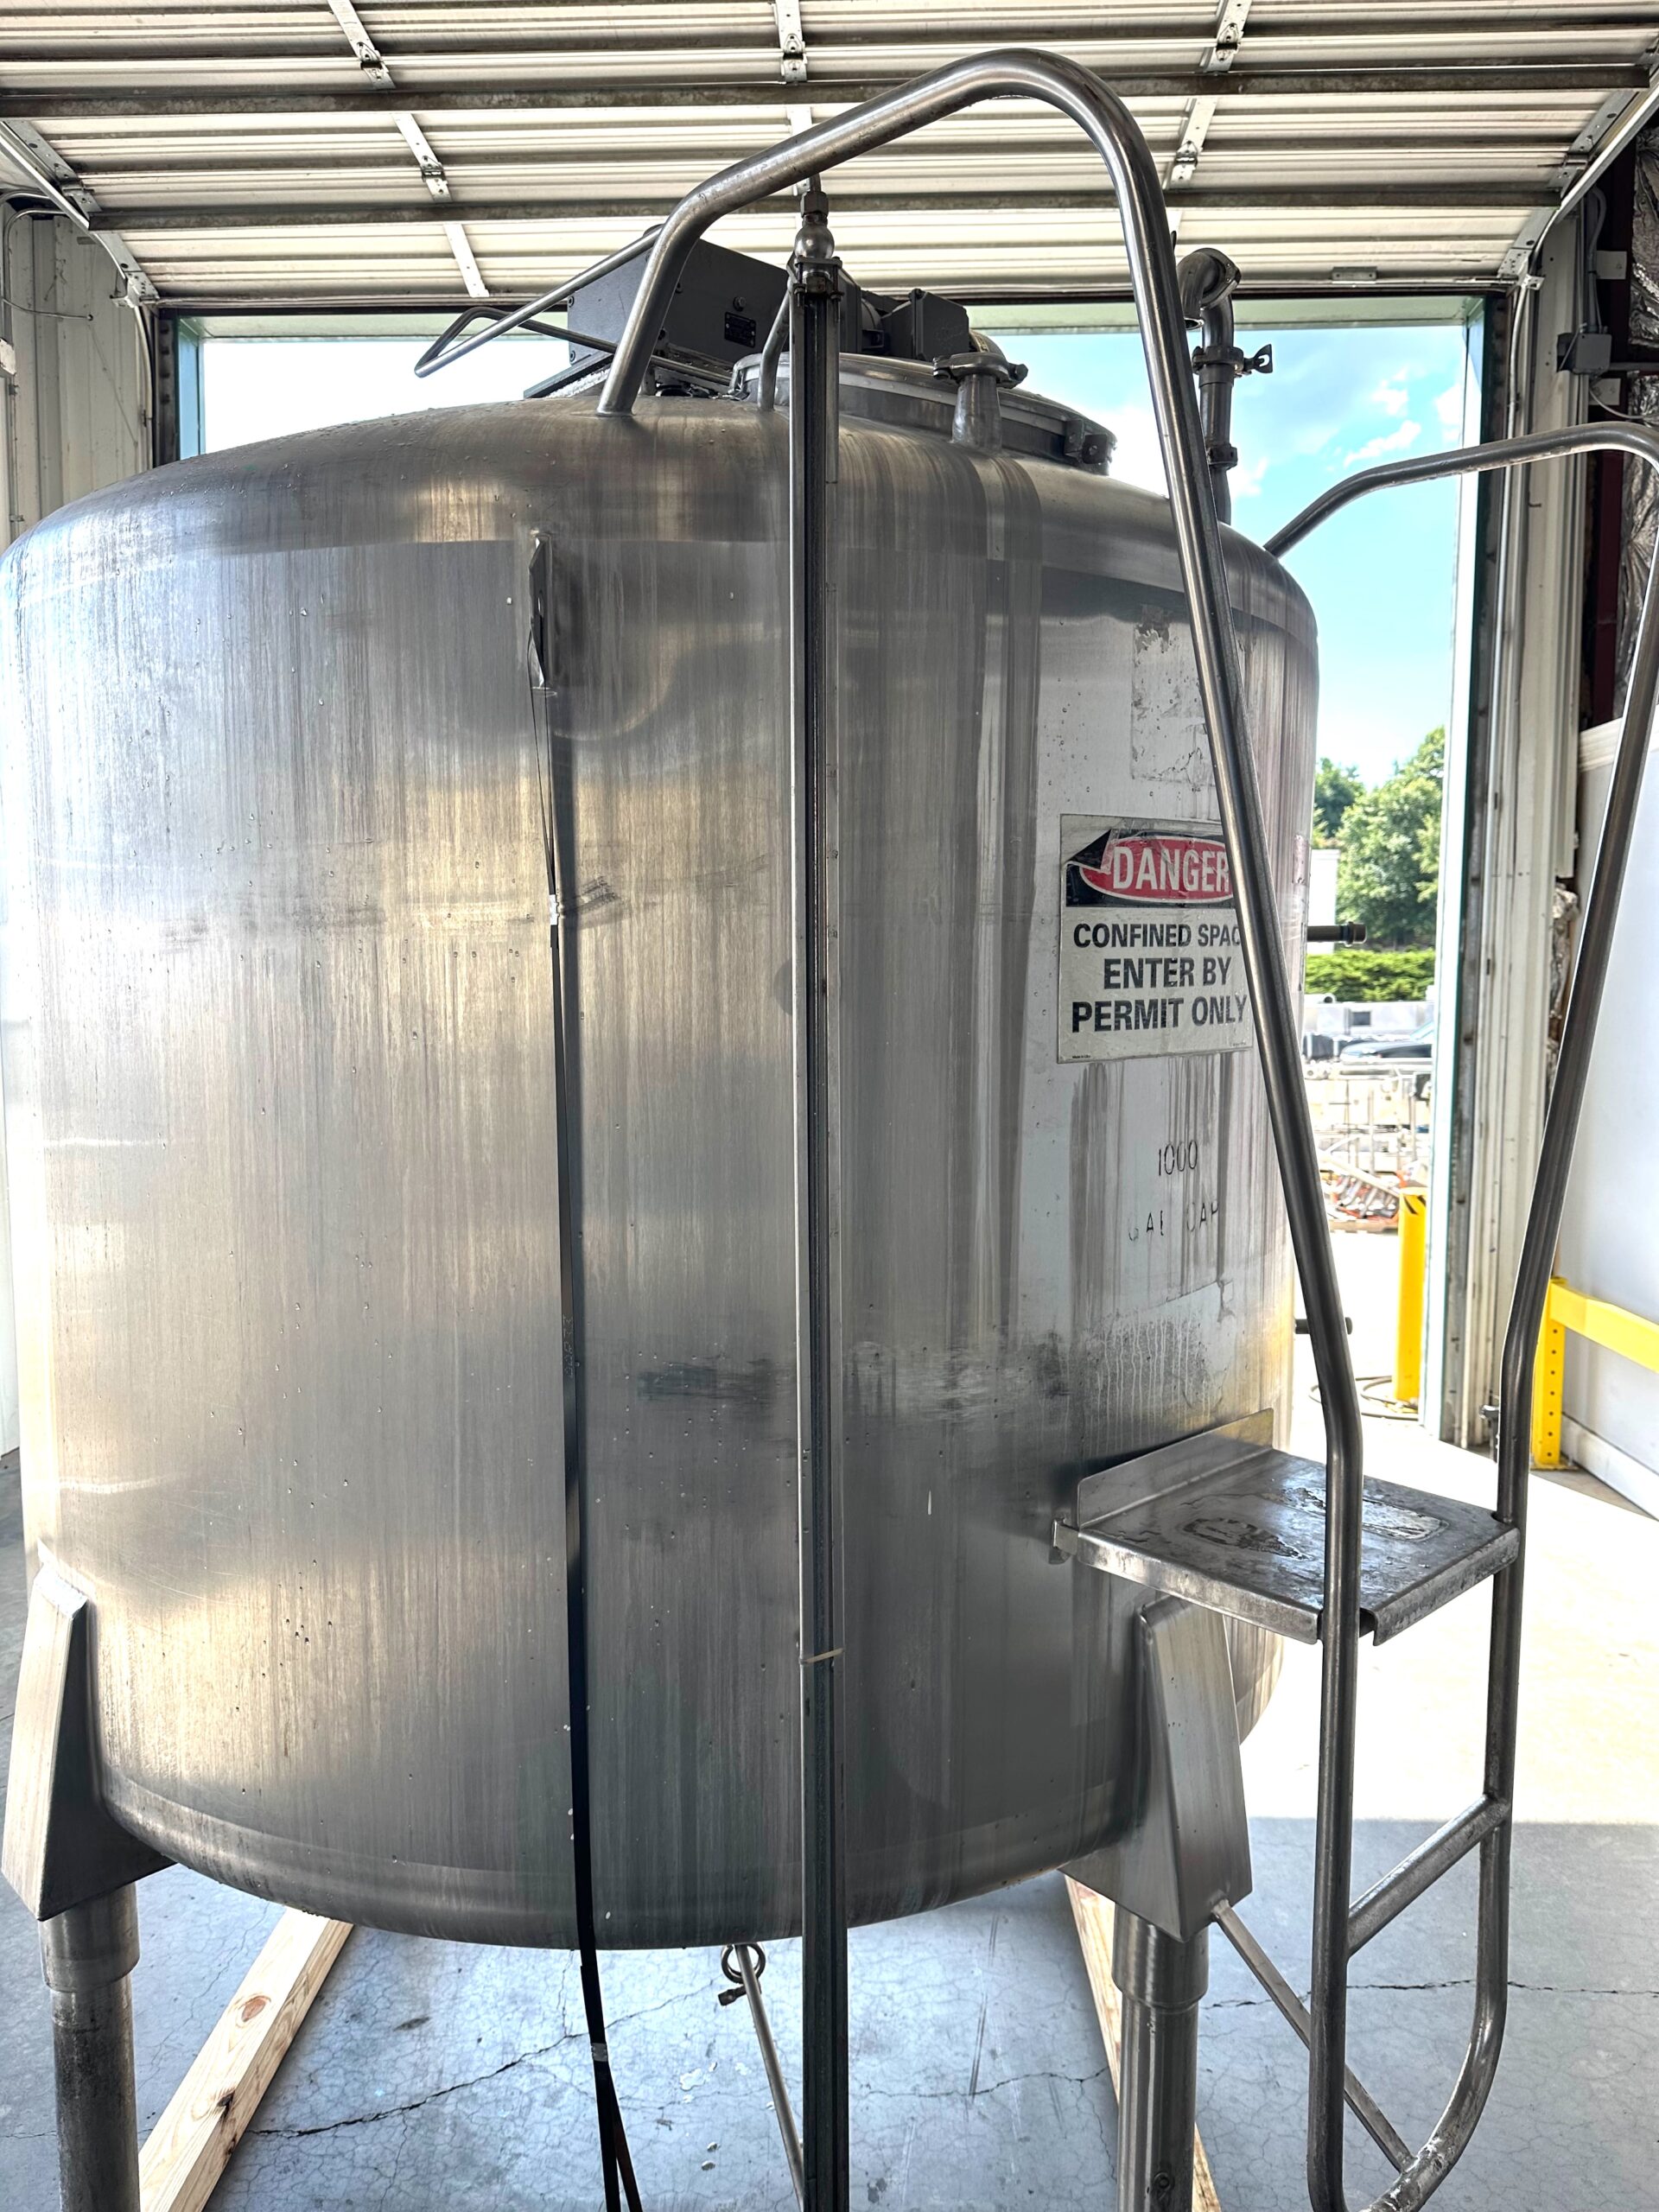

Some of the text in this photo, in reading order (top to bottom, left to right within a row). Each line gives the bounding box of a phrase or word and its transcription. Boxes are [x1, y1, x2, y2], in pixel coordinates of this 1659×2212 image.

[1113, 847, 1230, 893] DANGER
[1073, 923, 1242, 948] CONFINED SPAC
[1103, 957, 1232, 989] ENTER BY
[1071, 994, 1248, 1033] PERMIT ONLY
